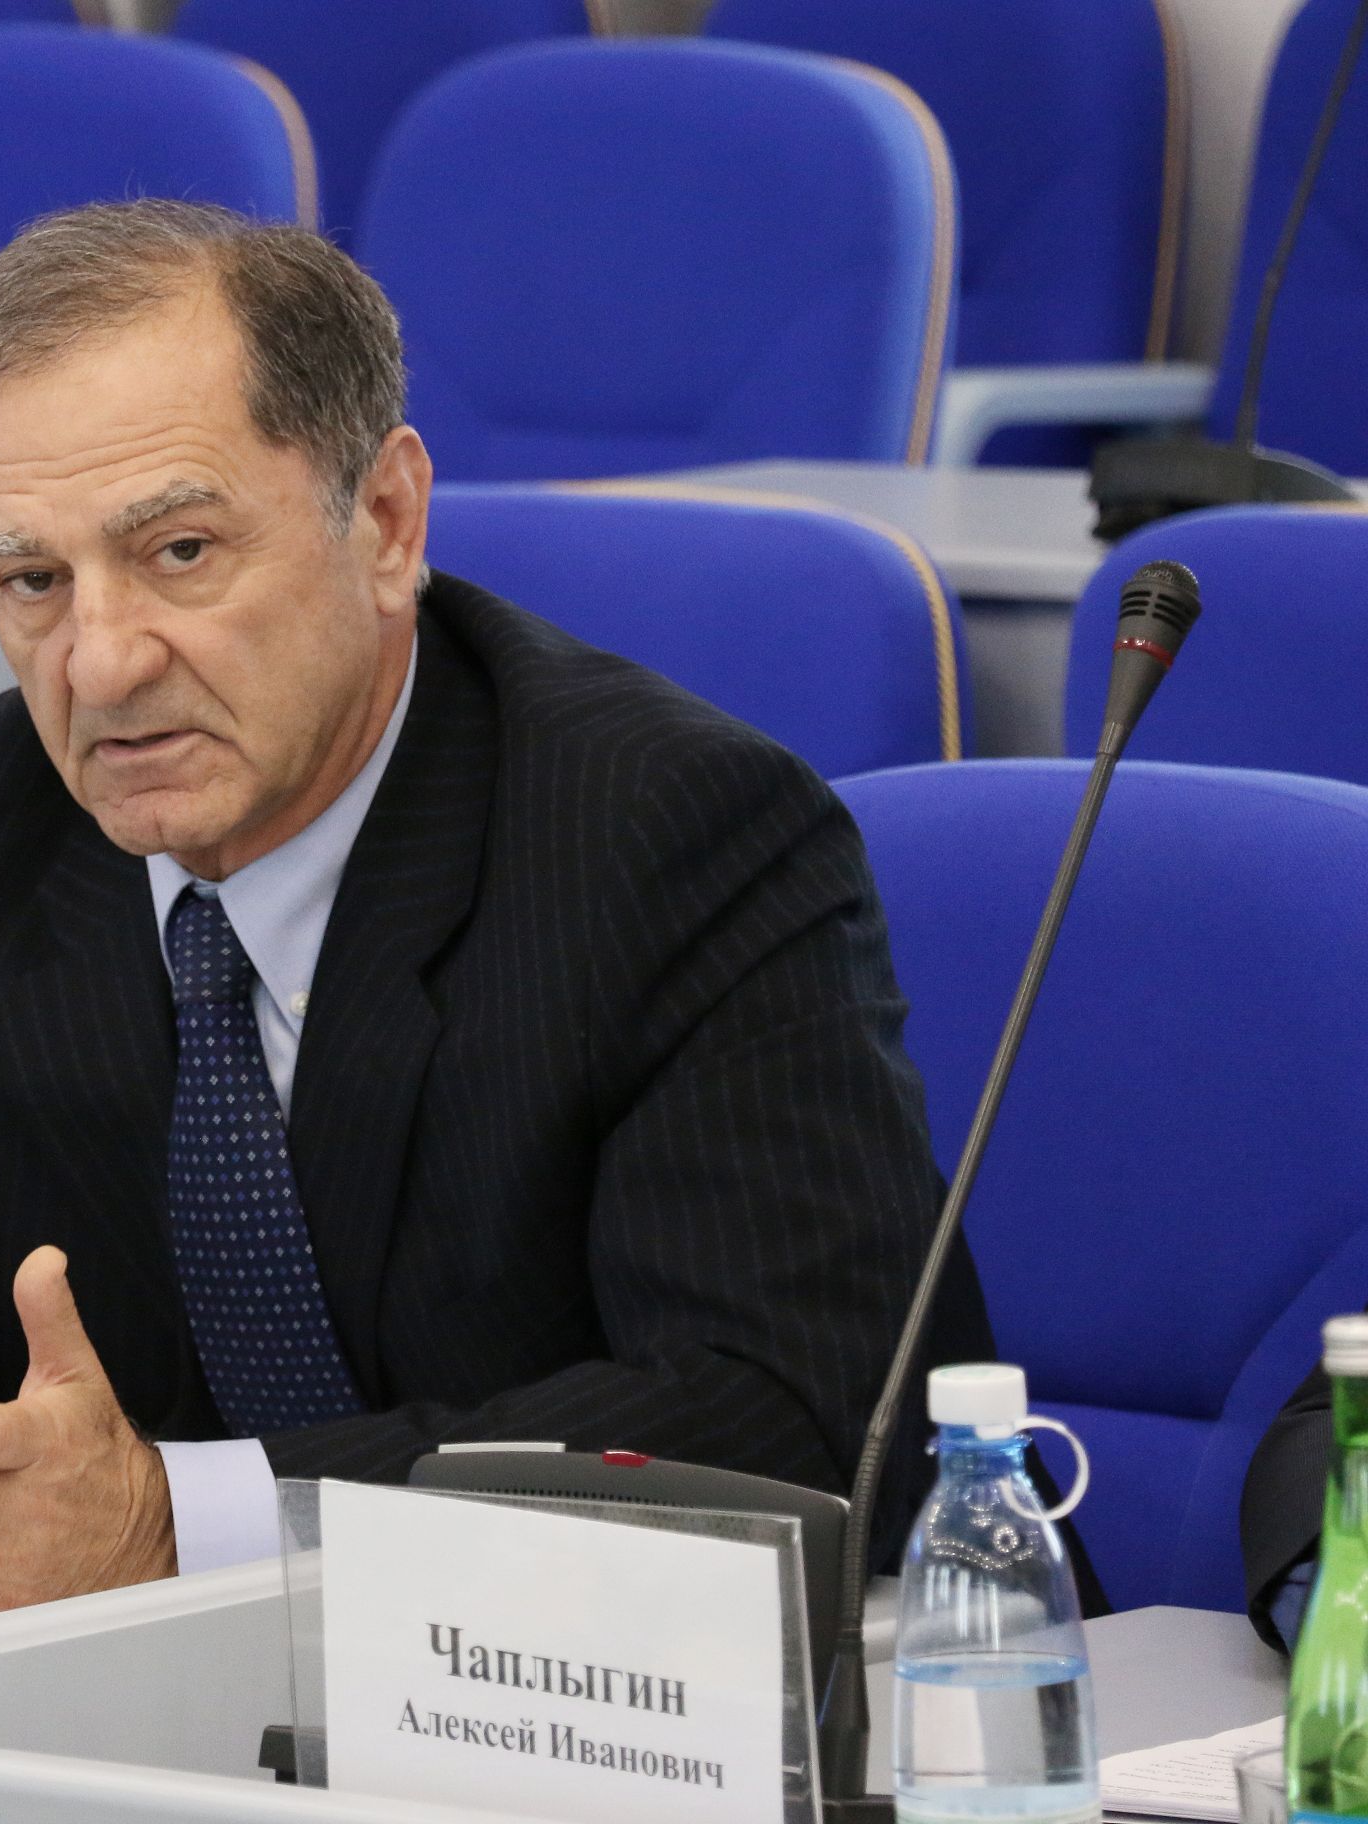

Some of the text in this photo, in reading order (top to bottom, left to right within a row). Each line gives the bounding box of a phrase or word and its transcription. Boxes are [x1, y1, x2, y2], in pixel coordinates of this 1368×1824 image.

[427, 1622, 687, 1717] Чаплыгин
[397, 1698, 726, 1790] Алексей Иванович
